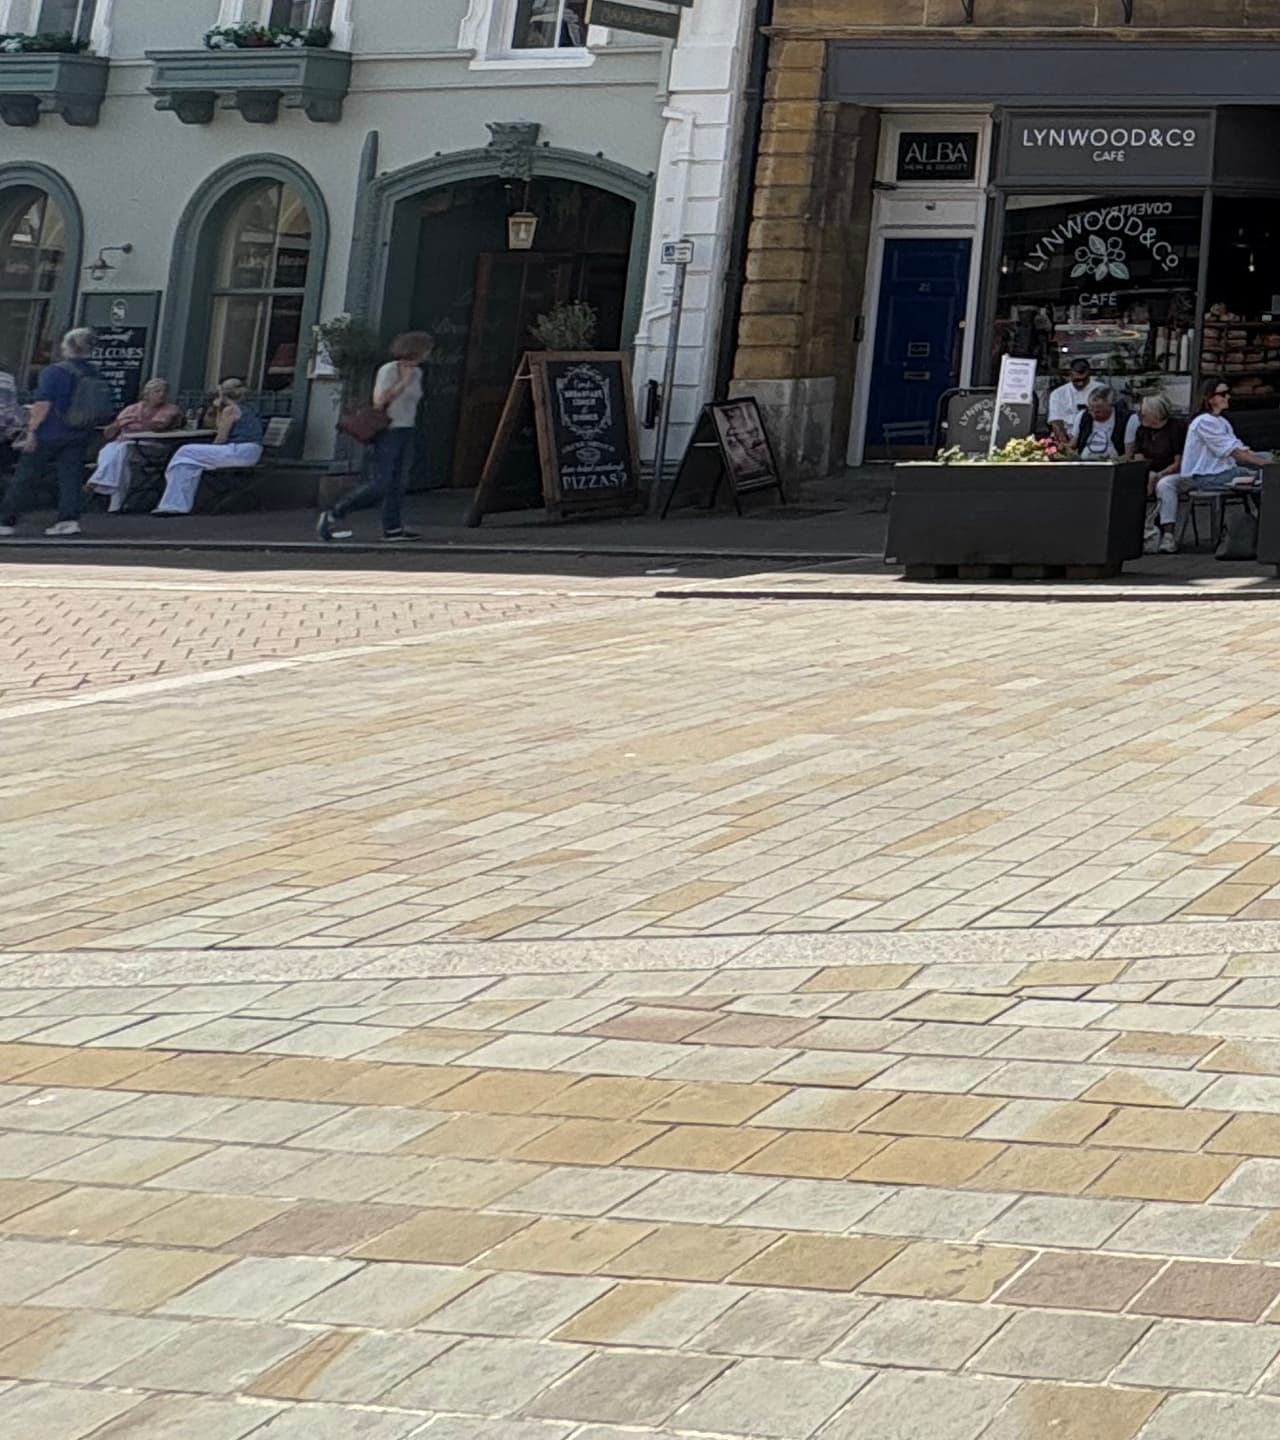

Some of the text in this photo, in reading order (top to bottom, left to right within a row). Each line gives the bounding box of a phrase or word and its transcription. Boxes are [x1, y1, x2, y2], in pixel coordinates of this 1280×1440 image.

[905, 141, 968, 163] ALBA
[1092, 149, 1126, 162] CAFÉ
[91, 347, 145, 359] ELCOMES
